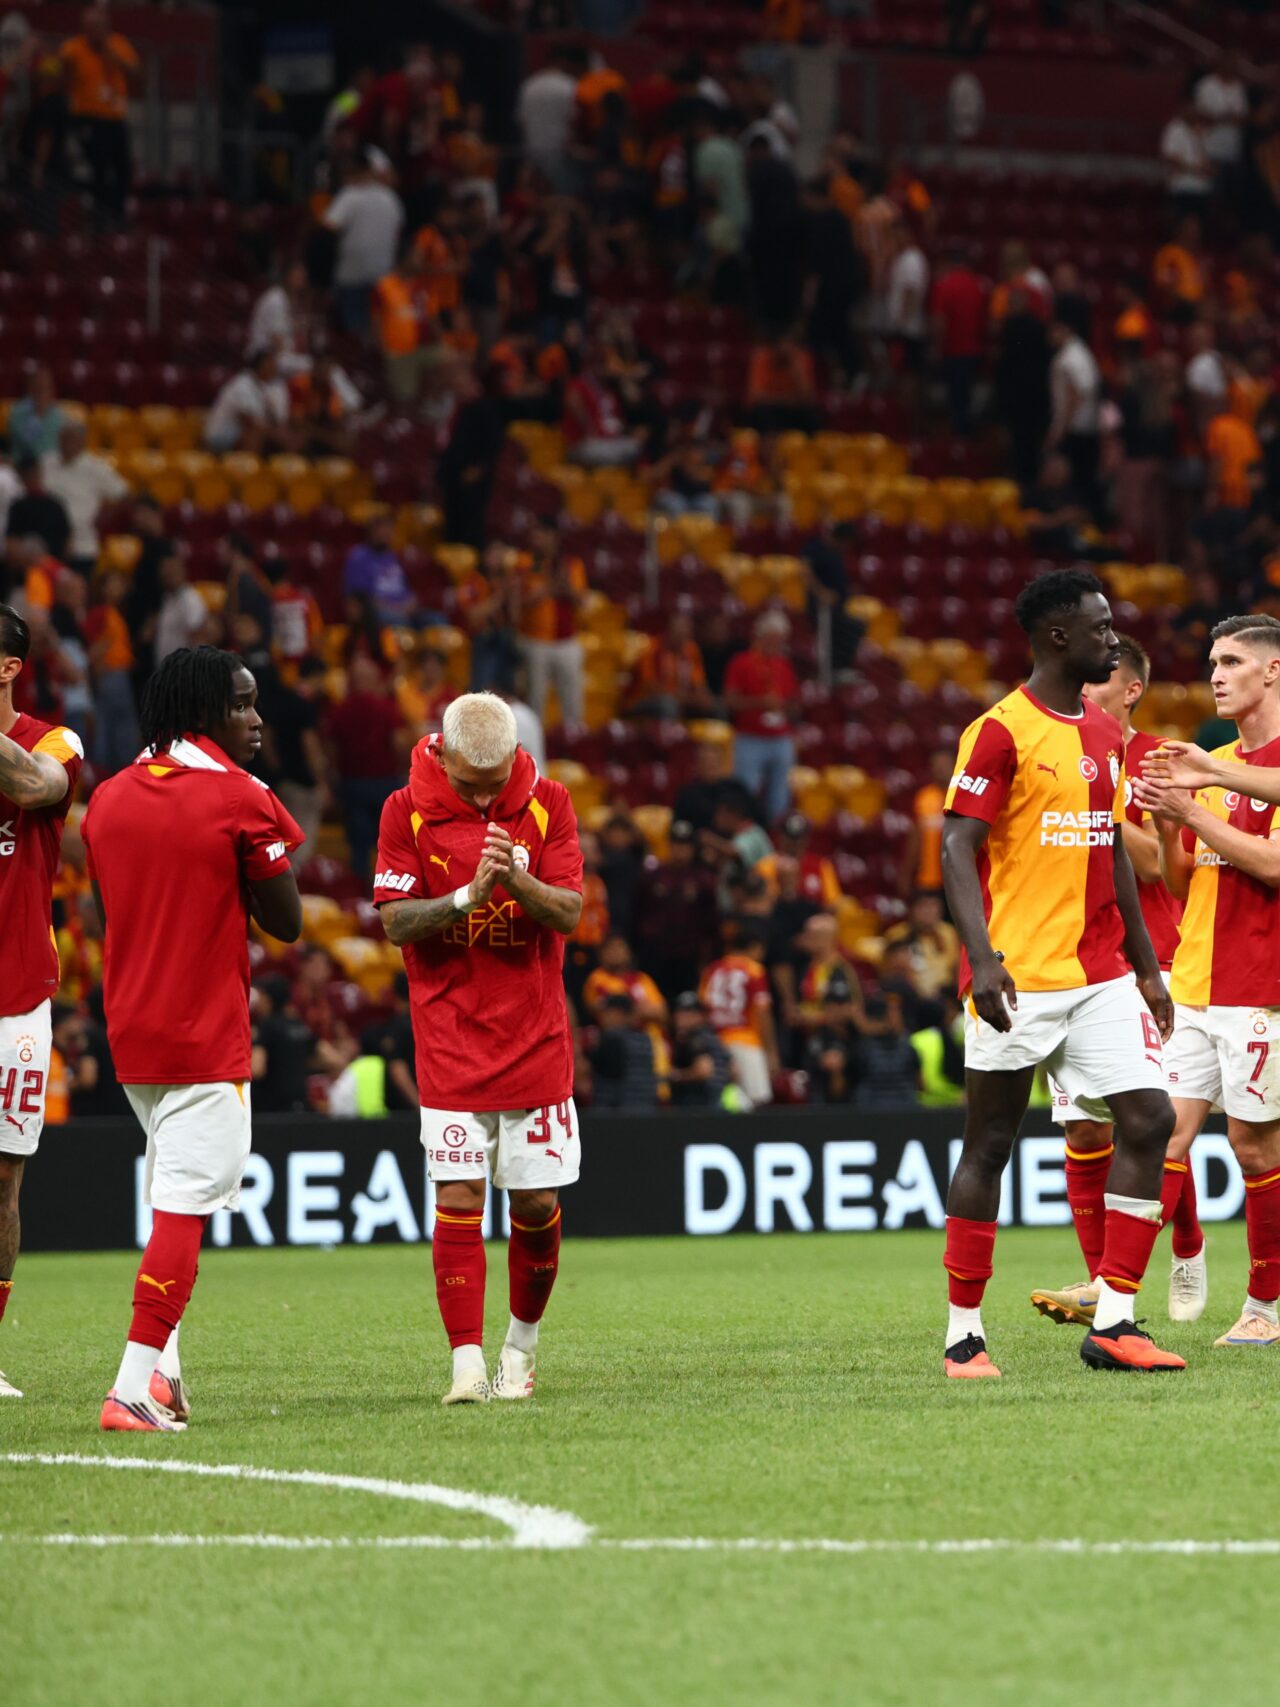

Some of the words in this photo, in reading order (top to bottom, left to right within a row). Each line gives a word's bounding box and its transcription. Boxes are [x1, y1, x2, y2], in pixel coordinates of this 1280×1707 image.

[466, 900, 517, 926] EXT
[1247, 1041, 1270, 1082] 7
[0, 1066, 44, 1114] 42
[527, 1101, 573, 1143] 34
[445, 1276, 467, 1286] GS
